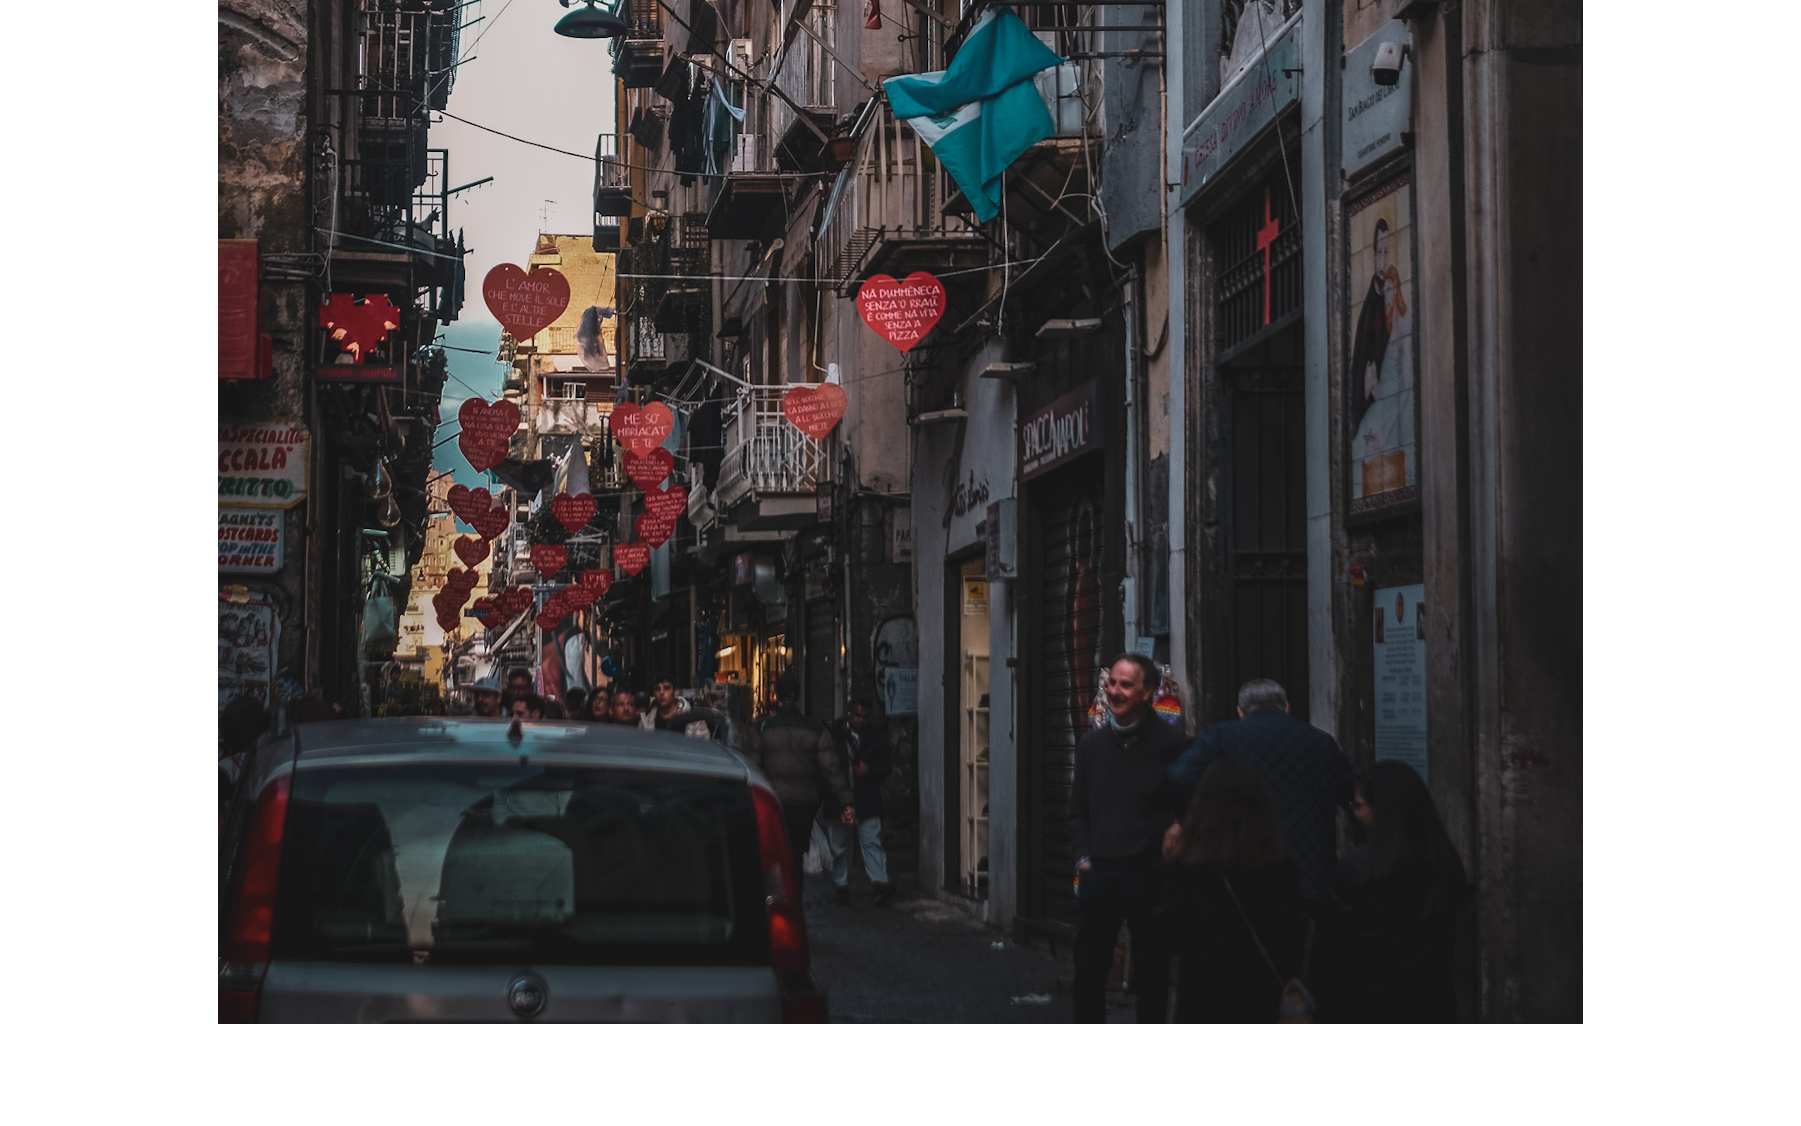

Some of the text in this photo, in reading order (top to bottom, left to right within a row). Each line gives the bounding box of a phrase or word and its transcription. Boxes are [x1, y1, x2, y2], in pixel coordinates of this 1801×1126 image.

[518, 281, 550, 294] AMOR
[488, 290, 567, 307] CHE MOVE IL SOLE
[865, 300, 897, 311] SENZA
[505, 314, 544, 327] STELLE
[876, 311, 903, 321] COMME
[884, 320, 912, 330] SENZA
[624, 413, 641, 425] ME
[641, 438, 656, 448] TE
[218, 513, 276, 526] AGNETS
[218, 542, 238, 554] OP
